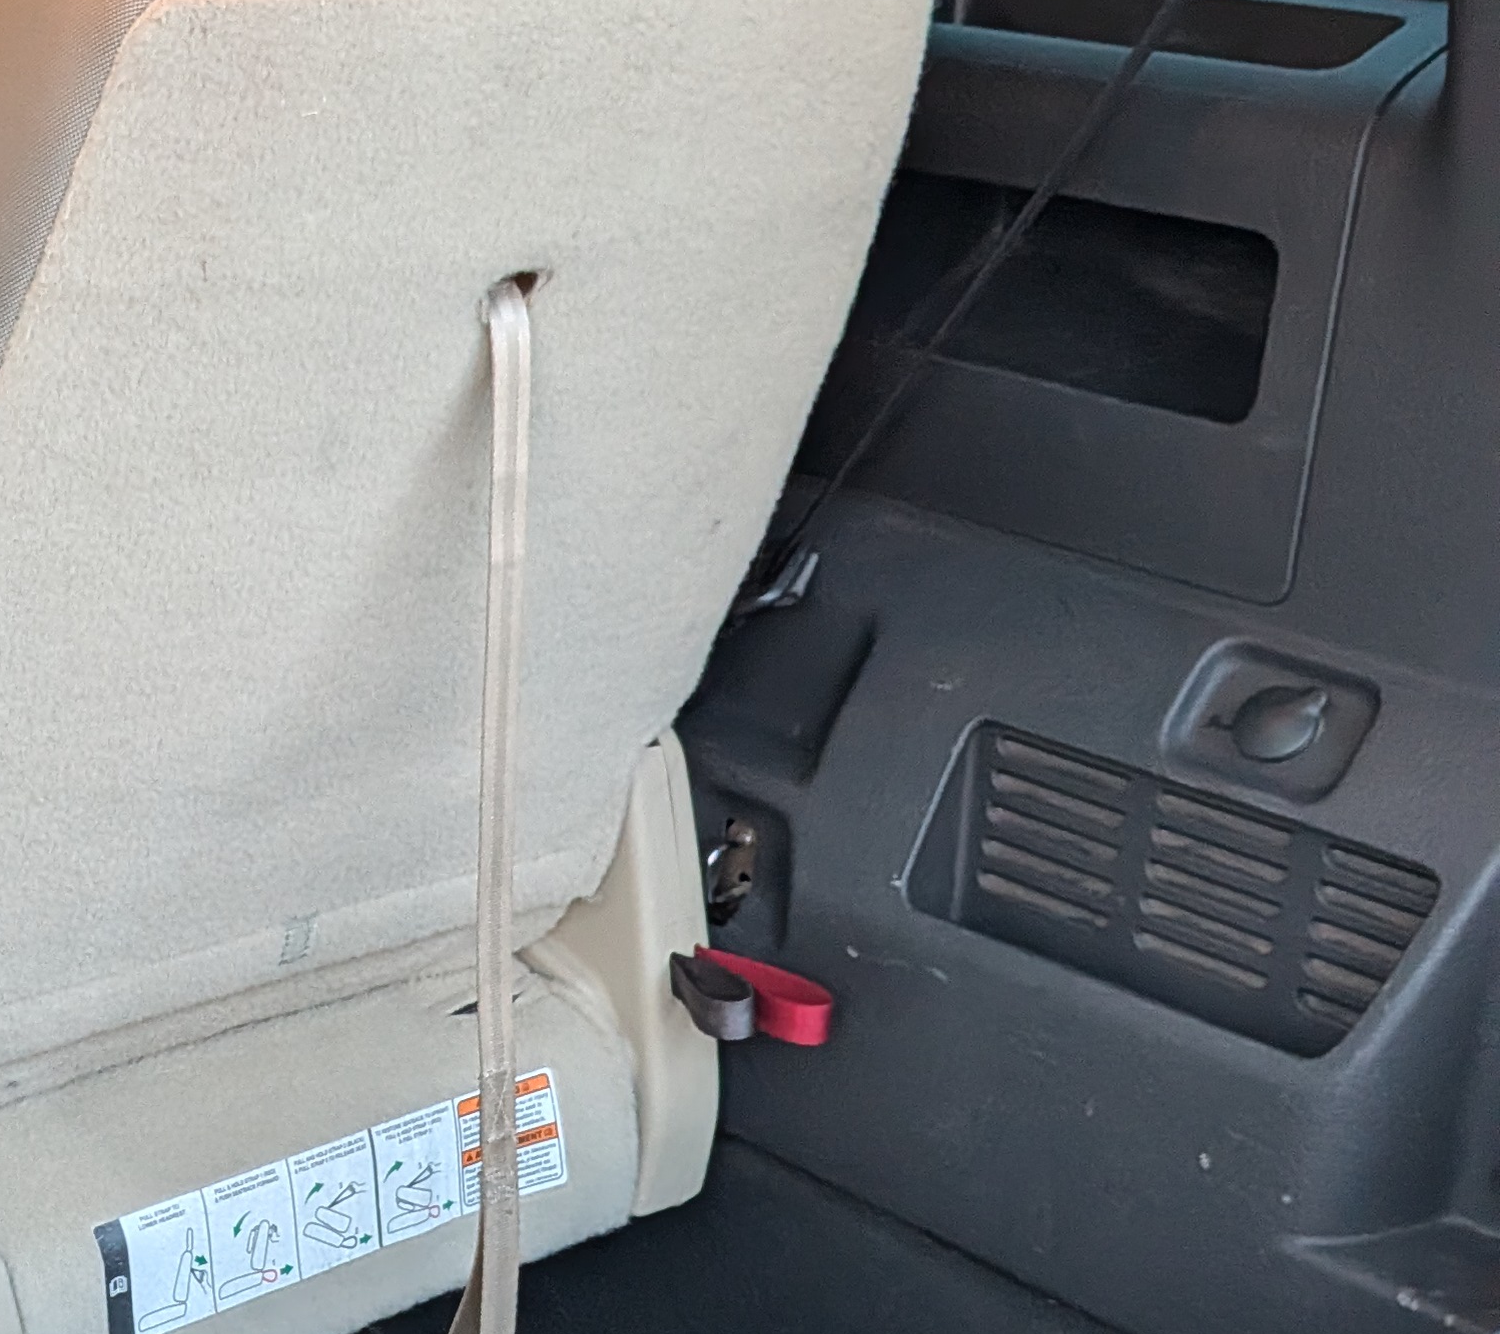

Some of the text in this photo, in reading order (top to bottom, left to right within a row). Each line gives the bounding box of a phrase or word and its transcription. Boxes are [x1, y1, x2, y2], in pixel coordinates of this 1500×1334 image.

[214, 1186, 225, 1194] PULL
[231, 1179, 243, 1188] HOLD
[244, 1173, 258, 1183] STRAP
[138, 1209, 185, 1230] LOWER HEADREST
[139, 1213, 152, 1221] PULL
[154, 1206, 171, 1216] STRAP
